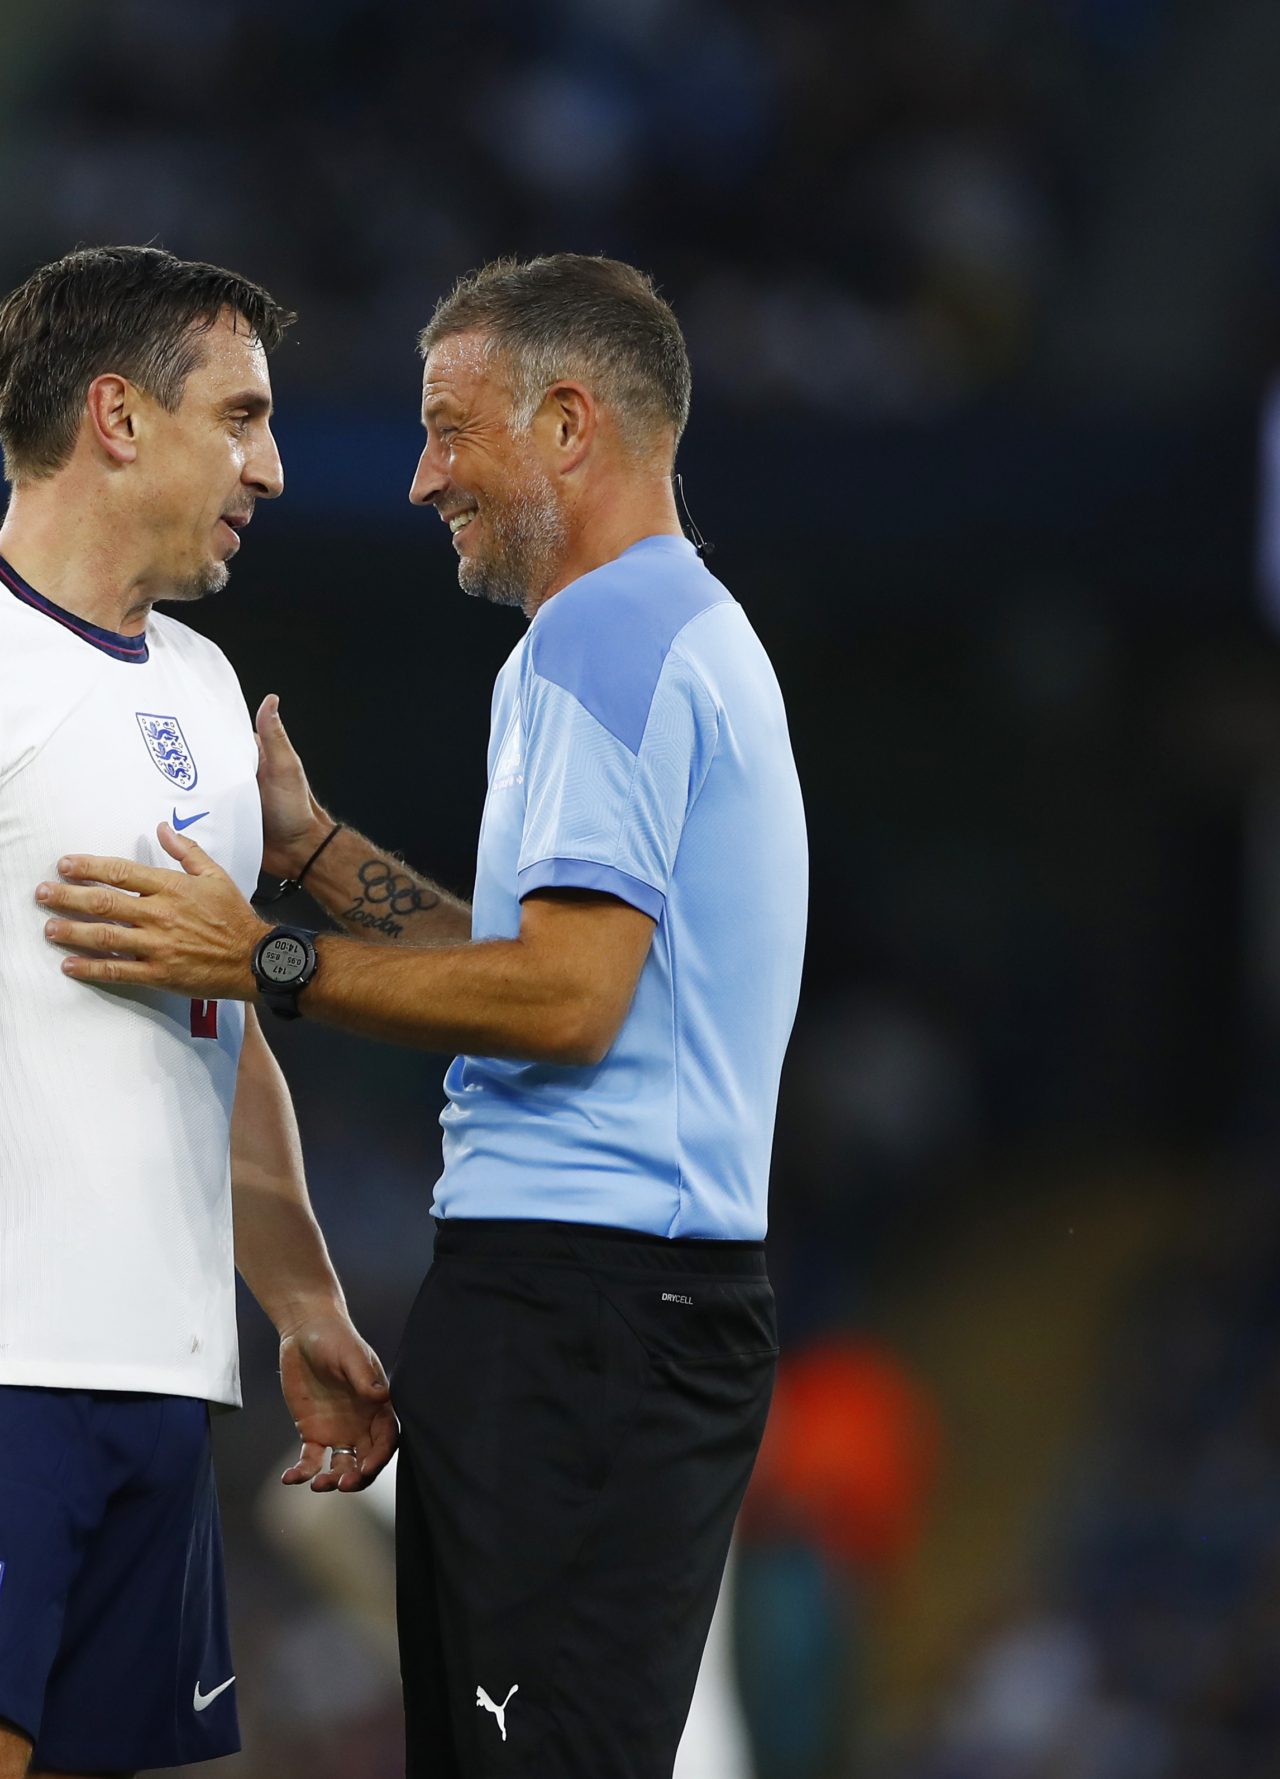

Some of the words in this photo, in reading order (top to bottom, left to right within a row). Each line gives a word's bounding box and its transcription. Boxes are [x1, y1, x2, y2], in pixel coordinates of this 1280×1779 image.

[342, 897, 403, 937] London
[274, 940, 298, 953] 14:00
[272, 965, 287, 975] 147
[661, 1292, 694, 1305] DRYCELL
